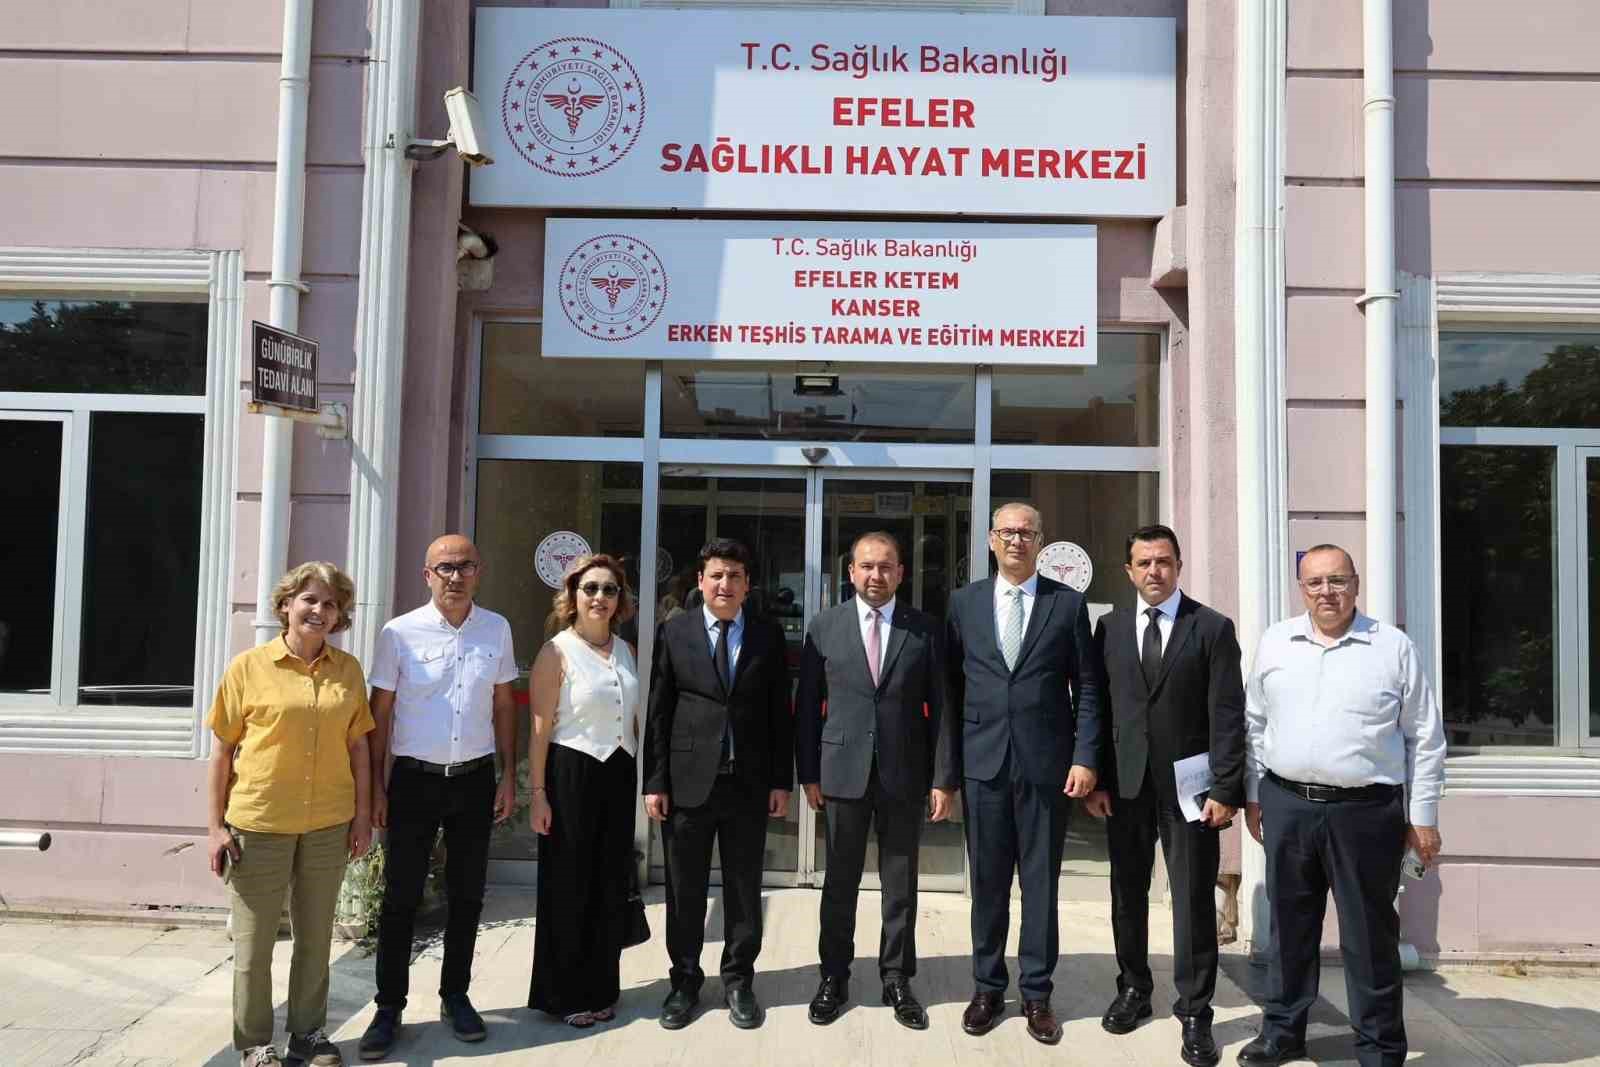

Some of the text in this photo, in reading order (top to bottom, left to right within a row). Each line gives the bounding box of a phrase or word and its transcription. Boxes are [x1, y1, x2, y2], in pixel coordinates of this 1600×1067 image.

[741, 42, 1067, 83] T.C. Sağlık Bakanlığı
[833, 97, 975, 128] EFELER
[660, 137, 1146, 180] SAĞLIKLI HAYAT MERKEZİ
[772, 237, 977, 263] T.C. Sağlık Bakanlığı
[794, 270, 959, 289] EFELER KETEM
[831, 298, 920, 317] KANSER
[668, 321, 1085, 348] ERKEN TEŞHİS TARAMA VE EĞİTİM MERKEZİ
[261, 336, 313, 370] GÜNÜBİRLİK
[257, 367, 314, 398] TEDAVİ ALANI
